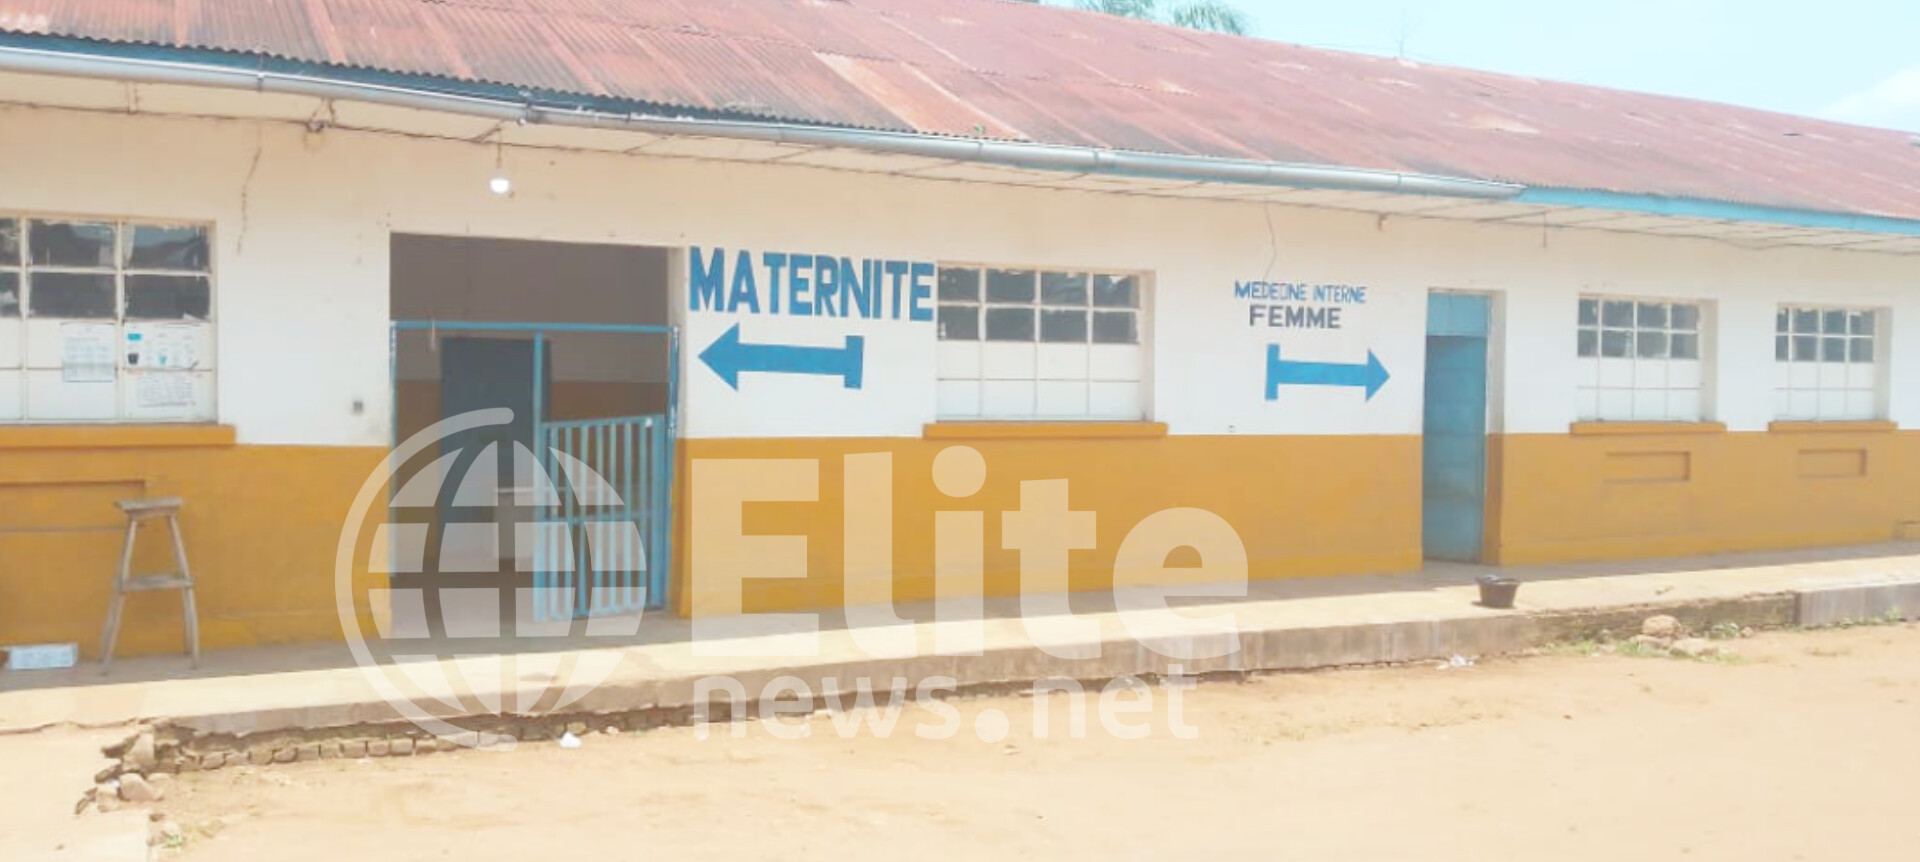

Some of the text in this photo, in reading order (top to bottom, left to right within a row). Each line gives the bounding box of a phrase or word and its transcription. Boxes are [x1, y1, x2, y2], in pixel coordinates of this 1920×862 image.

[689, 246, 935, 322] MATERNITE
[1313, 284, 1367, 304] INTERNE
[1249, 304, 1342, 329] FEMME
